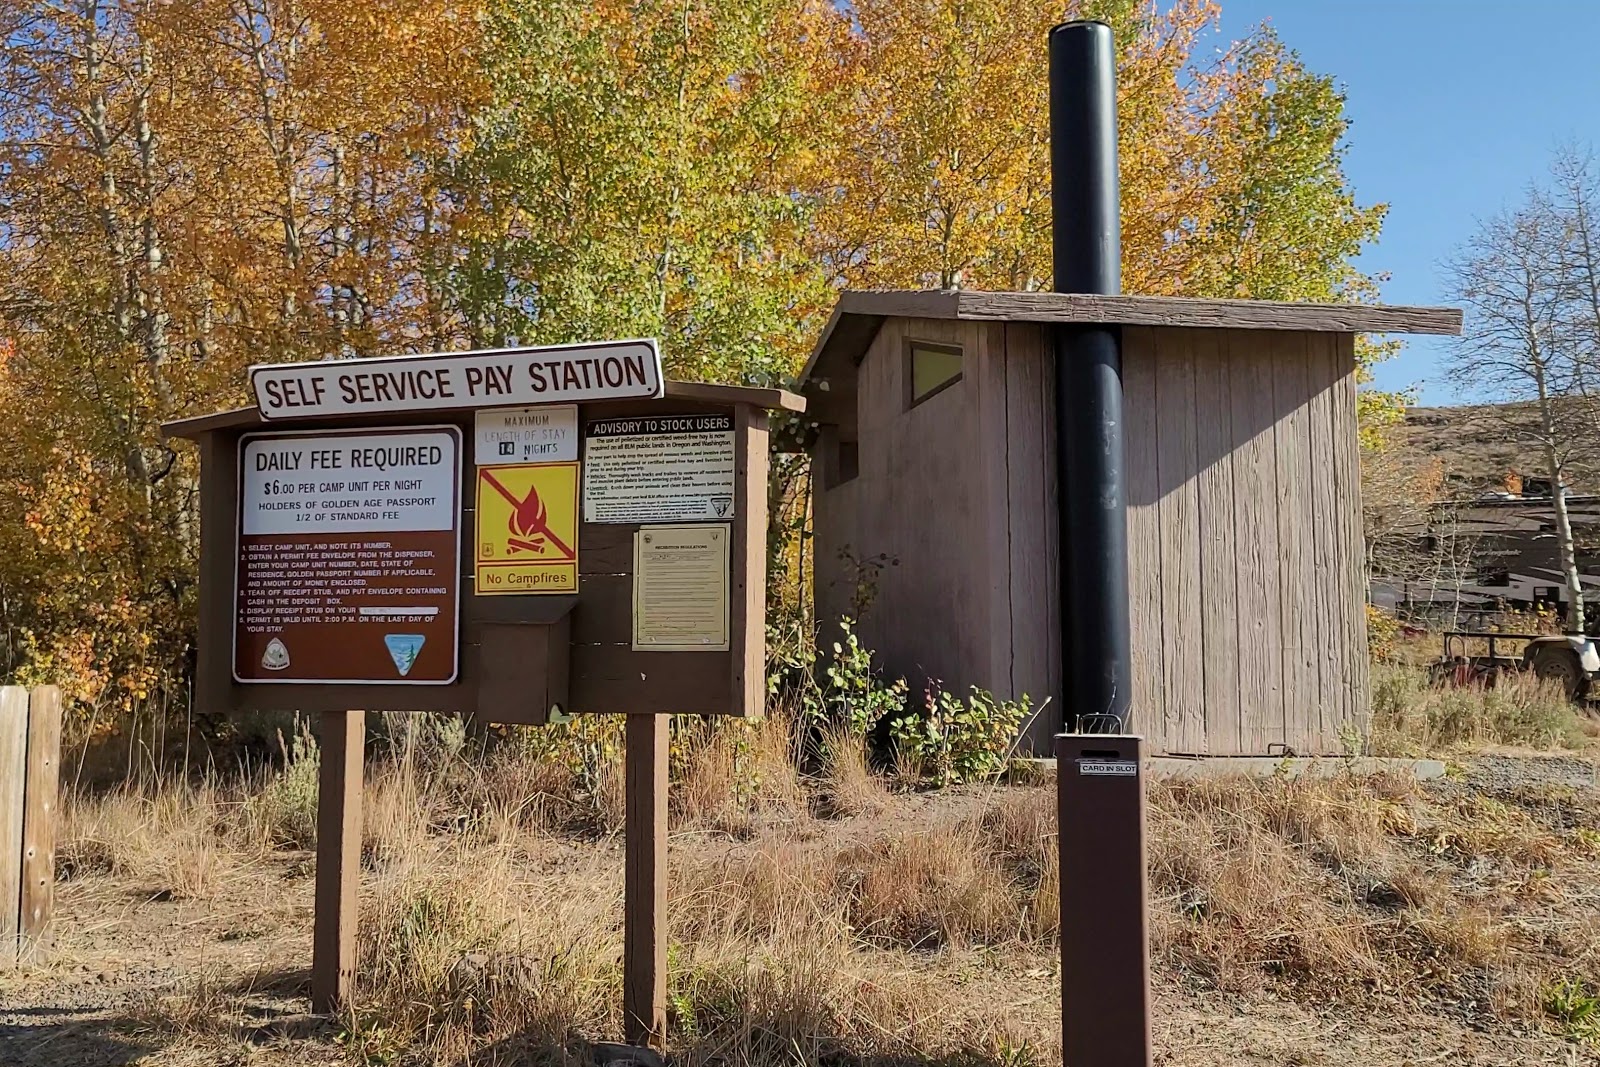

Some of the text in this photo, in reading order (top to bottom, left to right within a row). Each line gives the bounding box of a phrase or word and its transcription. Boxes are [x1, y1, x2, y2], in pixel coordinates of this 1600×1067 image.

[265, 356, 646, 408] SELF SERVICE PAY STATION
[504, 415, 549, 427] MAXIMUM
[594, 418, 730, 434] ADVISORY TO STOCK USERS
[484, 428, 566, 442] LENGTH OF STAY
[524, 443, 558, 455] NIGHTS
[256, 446, 442, 472] DAILY FEE REQUIRED
[264, 479, 422, 495] $6.00 PER CAMP UNIT PER NIGHT
[259, 497, 436, 510] HOLDERS OF GOLDEN AGE PASSPORT
[296, 511, 399, 521] 1/2 OF STANDARD FEE
[486, 572, 567, 584] No Campfires
